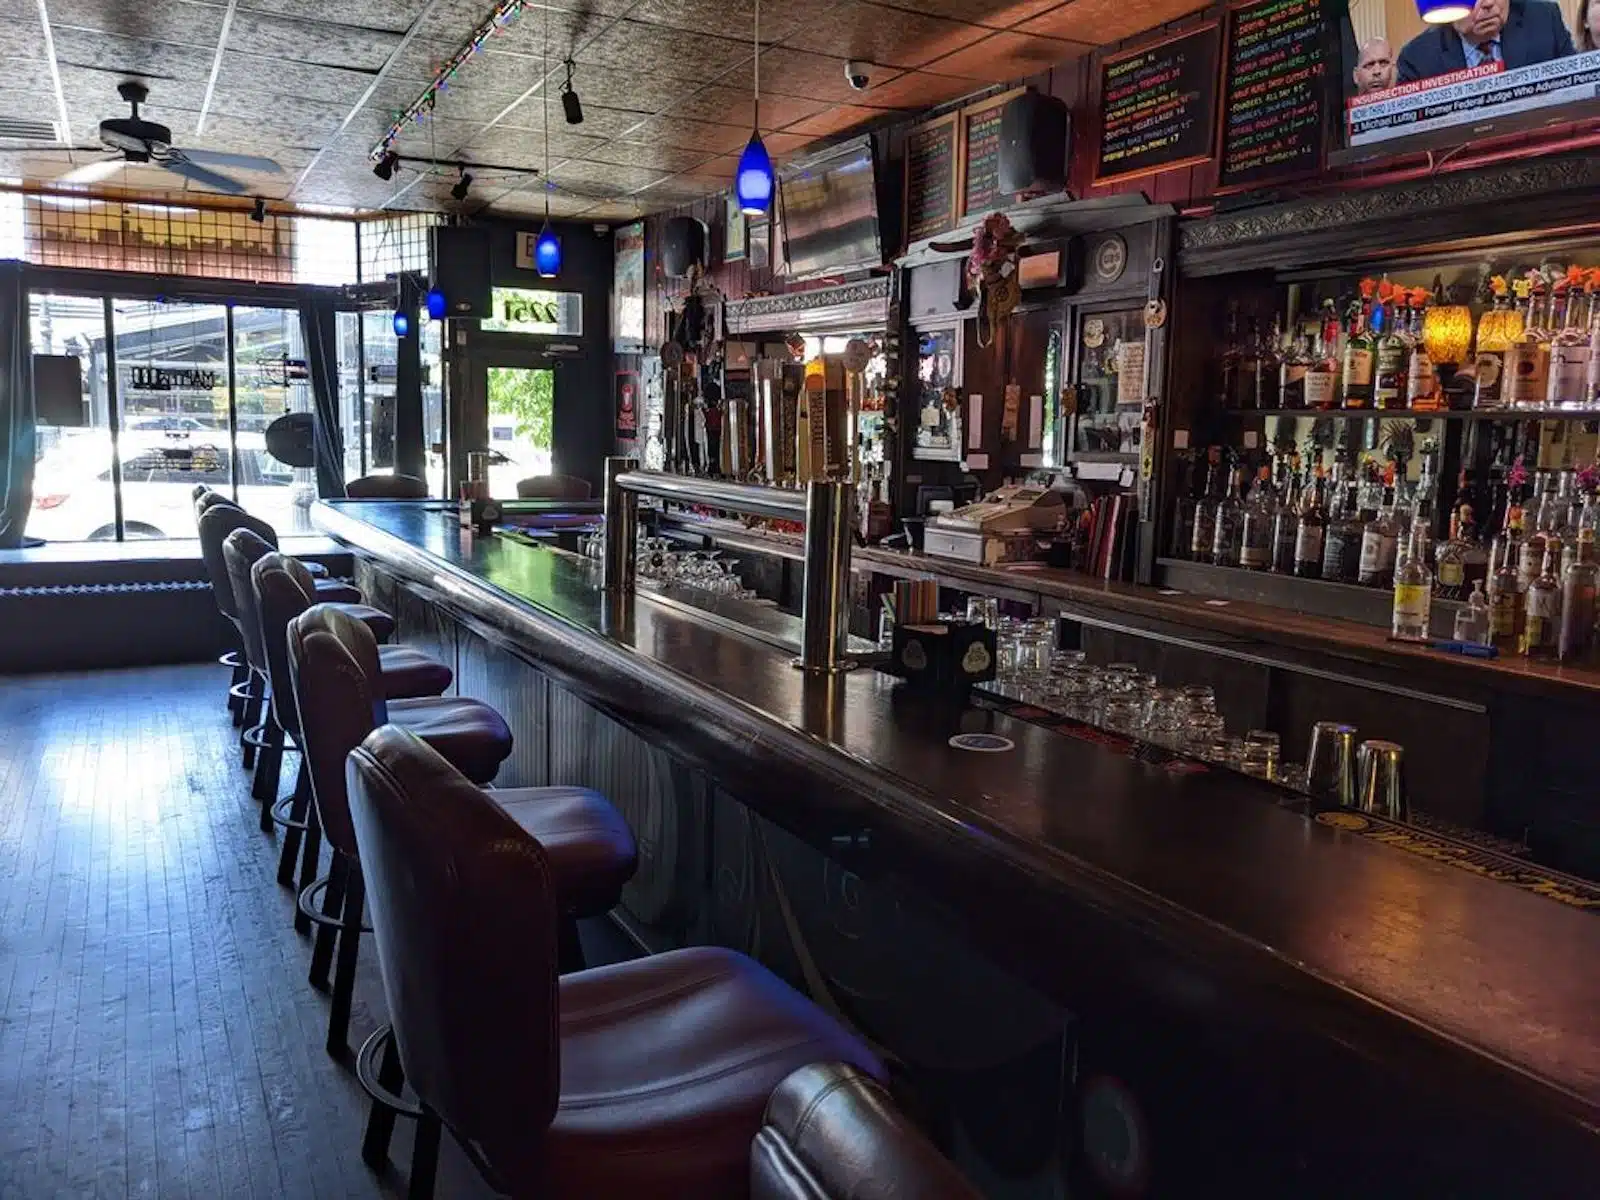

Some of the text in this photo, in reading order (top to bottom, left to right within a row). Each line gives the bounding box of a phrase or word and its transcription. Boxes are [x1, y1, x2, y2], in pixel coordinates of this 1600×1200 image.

[1354, 63, 1498, 104] INSURRECTION INVESTIGATION
[1494, 69, 1529, 87] ATTEMPTS
[1530, 67, 1539, 80] TO
[1540, 59, 1577, 76] PRESSURE
[1361, 114, 1392, 131] Michael
[1426, 102, 1453, 116] Former
[1454, 94, 1484, 111] Federal
[1486, 88, 1512, 104] Judge
[1513, 83, 1534, 98] Who
[1536, 77, 1571, 92] Advised
